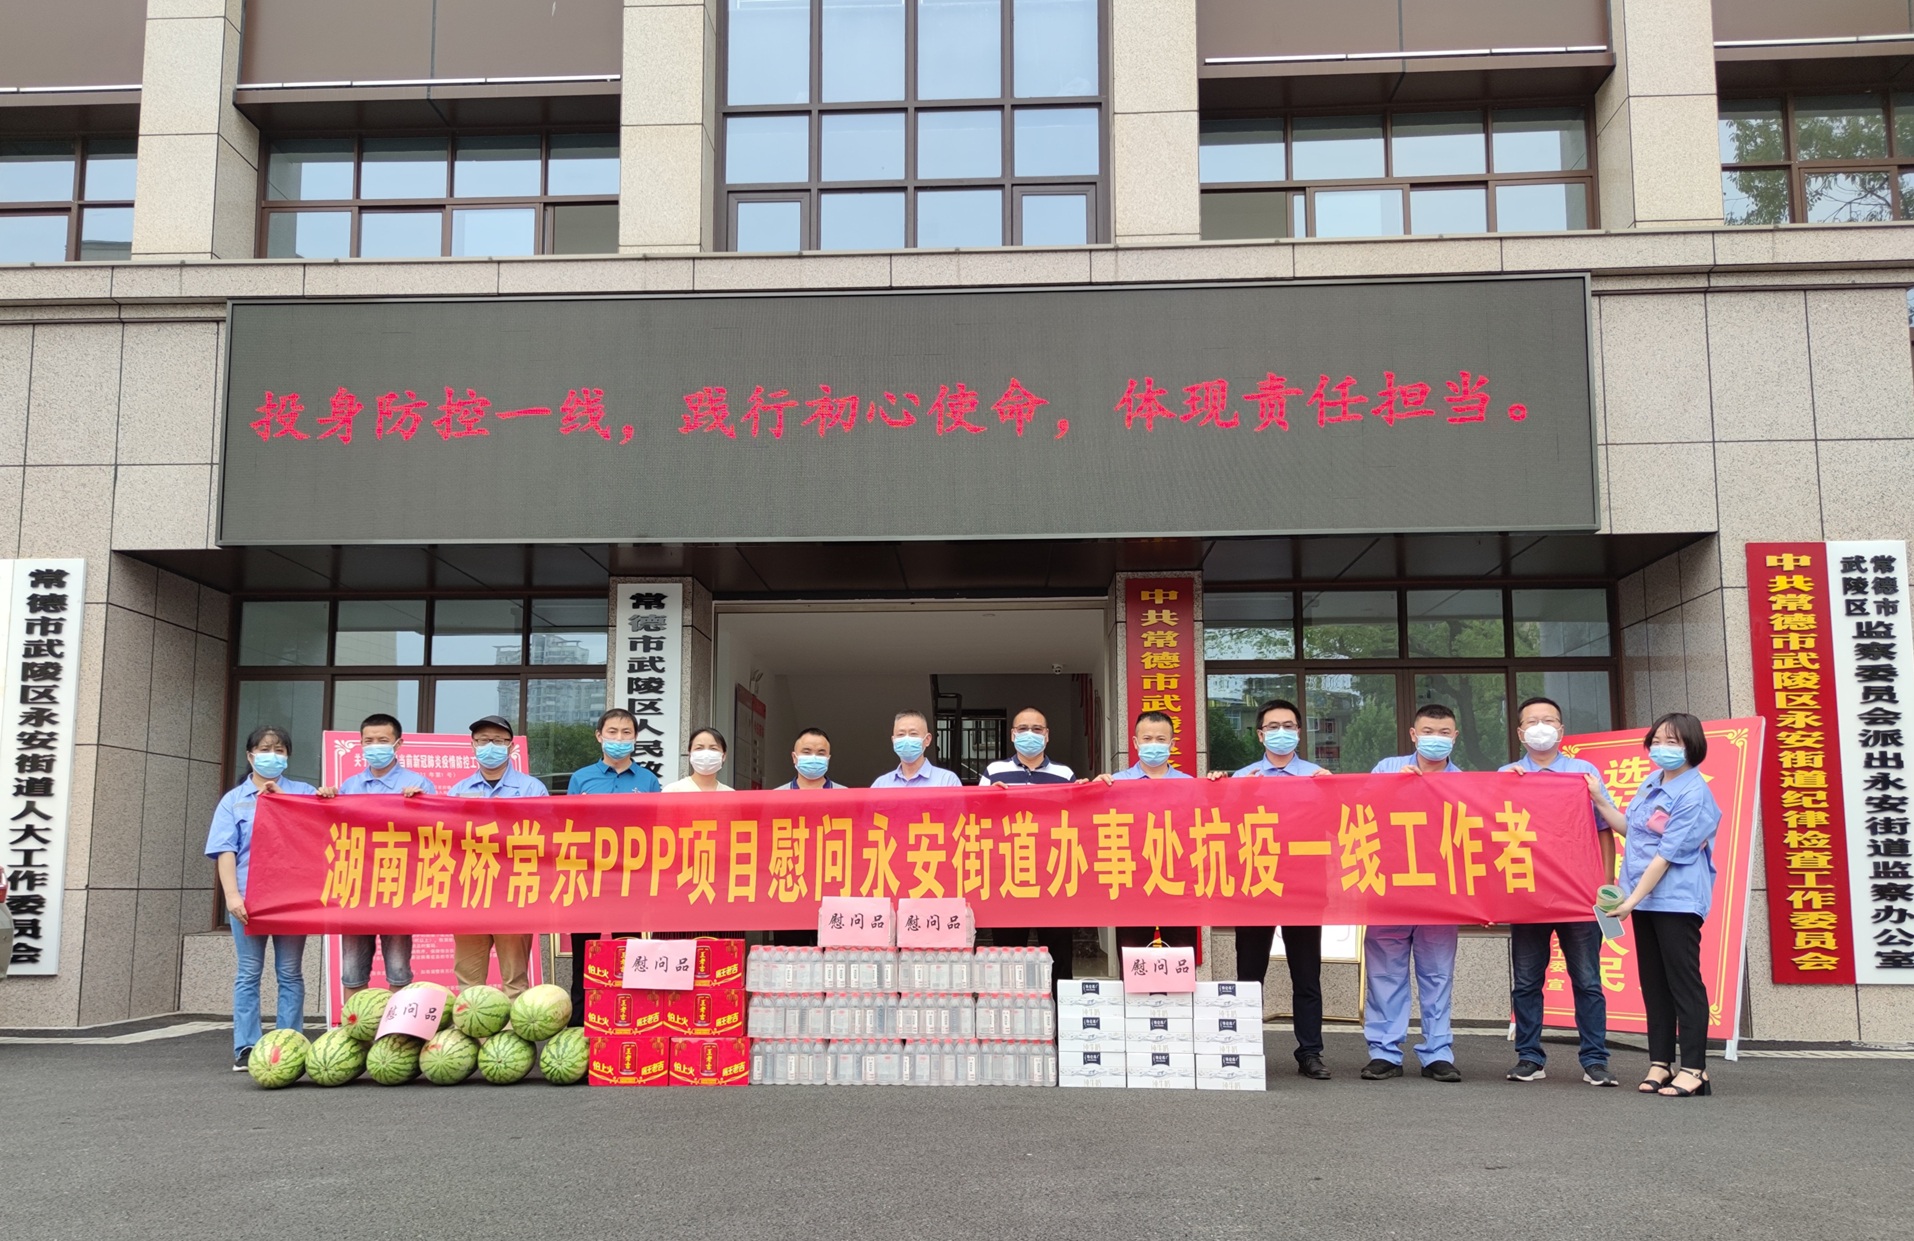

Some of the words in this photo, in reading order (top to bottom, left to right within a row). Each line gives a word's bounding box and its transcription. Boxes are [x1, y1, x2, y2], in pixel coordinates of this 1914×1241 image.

[627, 592, 668, 792] 常德市武陵区人民政
[1141, 588, 1182, 768] 中共常德市武
[6, 568, 71, 964] 常德市武陵区永安街道人大工作委员会
[1766, 553, 1840, 972] 中共常德市武陵区永安街道纪律检查工作委员会
[320, 800, 1538, 909] 湖南路桥常东PPP项目慰问永安街道办事处抗疫一线工作者
[632, 955, 690, 973] 慰问品
[829, 912, 885, 930] 慰问品
[905, 914, 961, 932] 慰问品
[1131, 958, 1190, 976] 慰问品
